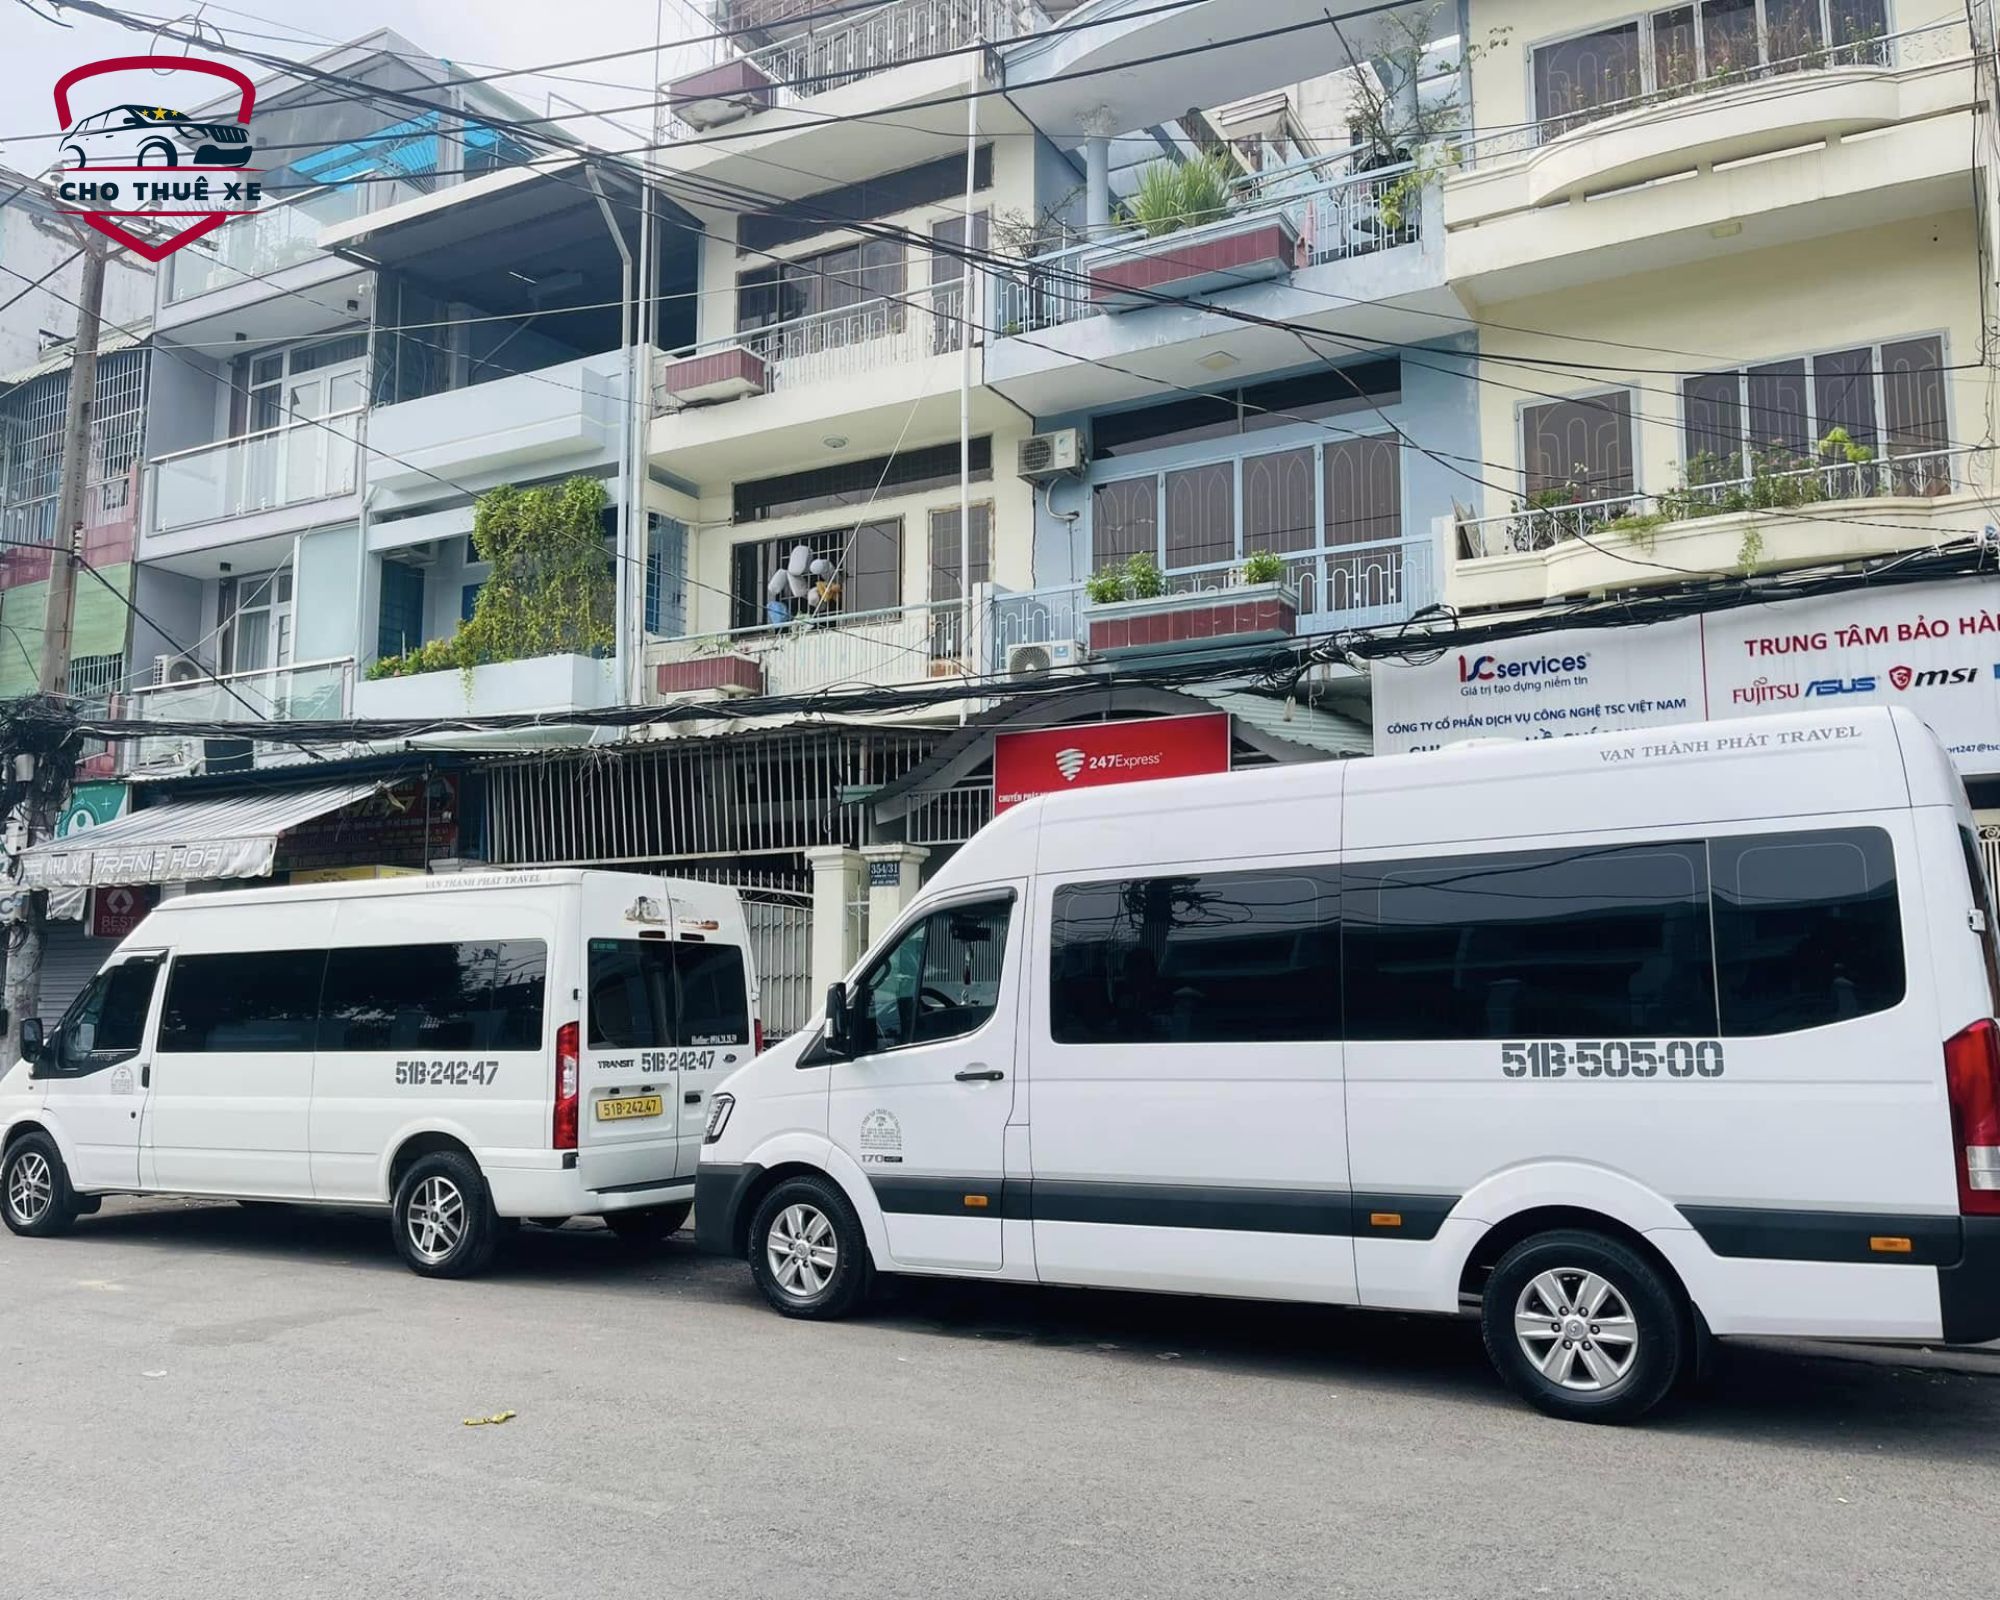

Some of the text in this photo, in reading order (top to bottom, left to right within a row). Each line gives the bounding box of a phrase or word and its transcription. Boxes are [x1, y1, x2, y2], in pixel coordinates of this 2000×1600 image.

[1744, 609, 2000, 657] TRUNG TÂM BẢO HÀ
[1733, 677, 1799, 705] FUJITSU
[1805, 677, 1876, 697] ASUS
[1387, 722, 1418, 734] CÔNG
[1420, 722, 1433, 731] TY
[1486, 714, 1512, 727] DỊCH
[1515, 713, 1531, 724] VỤ
[1533, 708, 1566, 721] CÔNG
[1569, 704, 1600, 718] NGHỆ
[1604, 703, 1626, 715] TSC
[1628, 700, 1653, 713] VIỆT
[1657, 698, 1687, 710] NAM
[1600, 725, 1863, 763] VẠN THÀNH PHÁT TRAVEL
[1089, 753, 1161, 769] 247Express
[94, 853, 166, 873] TRANG
[101, 916, 136, 928] BEST
[597, 1059, 635, 1069] TRANSIT
